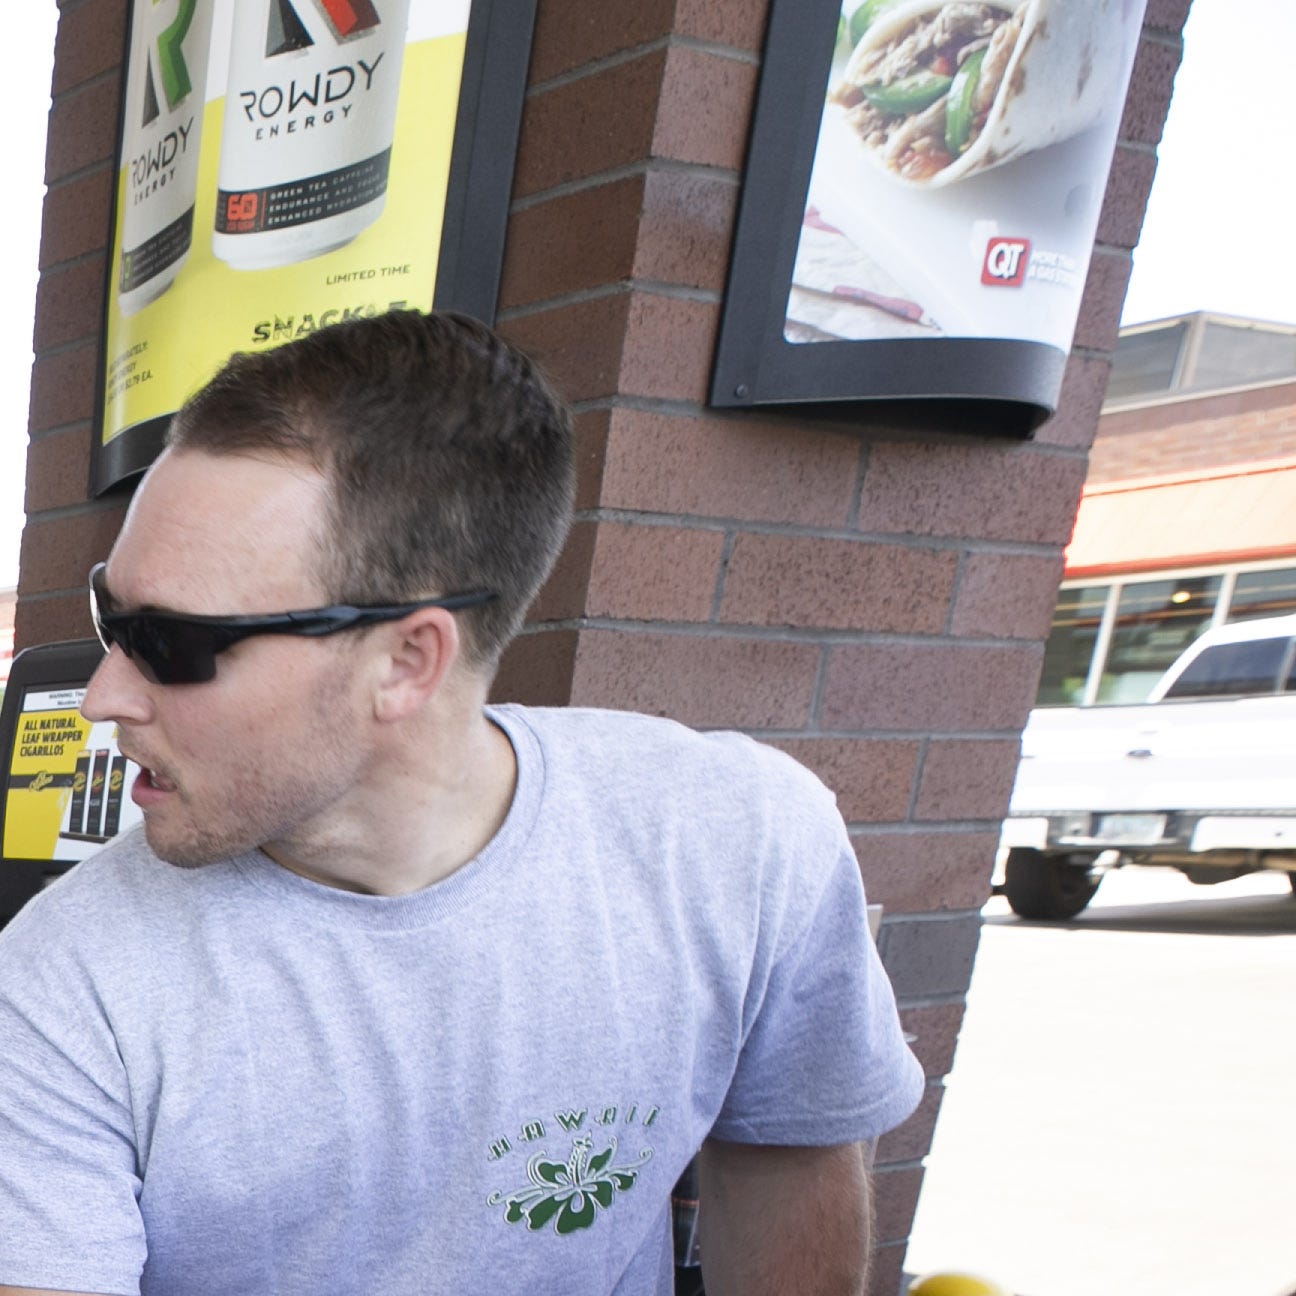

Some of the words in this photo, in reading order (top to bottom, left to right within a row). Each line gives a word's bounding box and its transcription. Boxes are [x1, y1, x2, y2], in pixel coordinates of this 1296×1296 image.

[240, 52, 385, 122] ROWDY
[256, 103, 353, 140] ENERGY
[131, 116, 195, 189] ROWDY
[134, 166, 176, 206] ENERGY
[308, 181, 327, 191] TEA
[326, 269, 376, 286] LIMITED
[380, 264, 411, 277] TIME
[987, 242, 1025, 279] QT
[22, 732, 41, 744] LEAF
[43, 730, 82, 743] WRAPPER
[24, 719, 37, 731] ALL
[40, 717, 76, 729] NATURAL
[20, 744, 64, 757] CIGARILLOS
[487, 1102, 660, 1161] HAWAII
